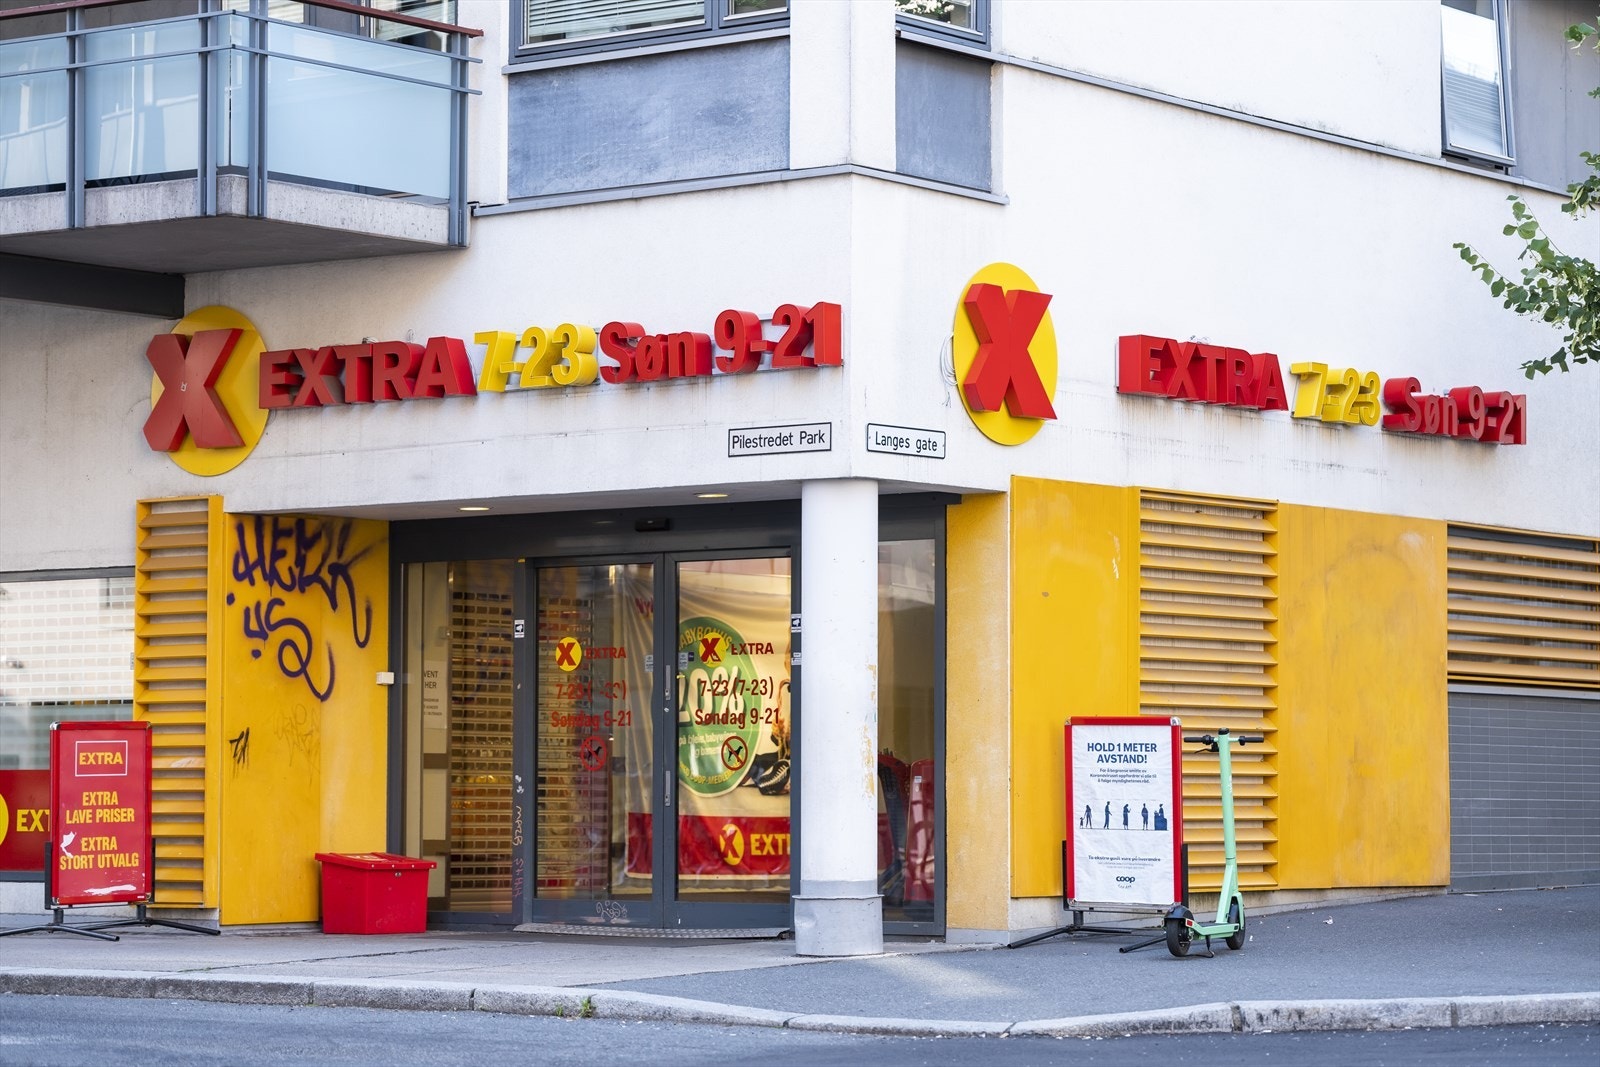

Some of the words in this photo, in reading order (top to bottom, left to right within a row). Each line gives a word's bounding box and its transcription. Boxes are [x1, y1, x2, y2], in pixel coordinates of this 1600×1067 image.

[259, 335, 477, 410] EXTRA
[474, 322, 599, 393] 7-23
[600, 321, 713, 385] Søn
[714, 301, 842, 374] 9-21
[1117, 334, 1289, 412] EXTRA
[1291, 361, 1381, 427] 7-23
[1382, 376, 1459, 436] Søn
[1450, 385, 1527, 445] 9-21
[732, 432, 794, 450] Pilestredet
[800, 430, 825, 445] Park
[875, 431, 910, 451] Langes
[916, 439, 938, 453] gate
[586, 647, 627, 660] EXTRA
[731, 642, 774, 655] EXTRA
[424, 681, 437, 689] HER
[700, 679, 729, 697] 7-23
[732, 676, 774, 699] (7-23)
[551, 710, 600, 731] Søndag
[695, 708, 746, 729] Søndag
[750, 707, 780, 725] 9-21
[1087, 742, 1115, 752] HOLD
[1117, 742, 1121, 752] 1
[1123, 742, 1157, 752] METER
[79, 751, 124, 766] EXTRA
[1096, 754, 1148, 764] AVSTAND!
[82, 791, 119, 806] EXTRA
[66, 809, 93, 825] LAVE
[95, 807, 135, 824] PRISER
[81, 836, 118, 852] EXTRA
[750, 833, 791, 856] EXT
[59, 855, 95, 870] STORT
[97, 852, 140, 869] UTVALG
[1115, 875, 1136, 884] coop
